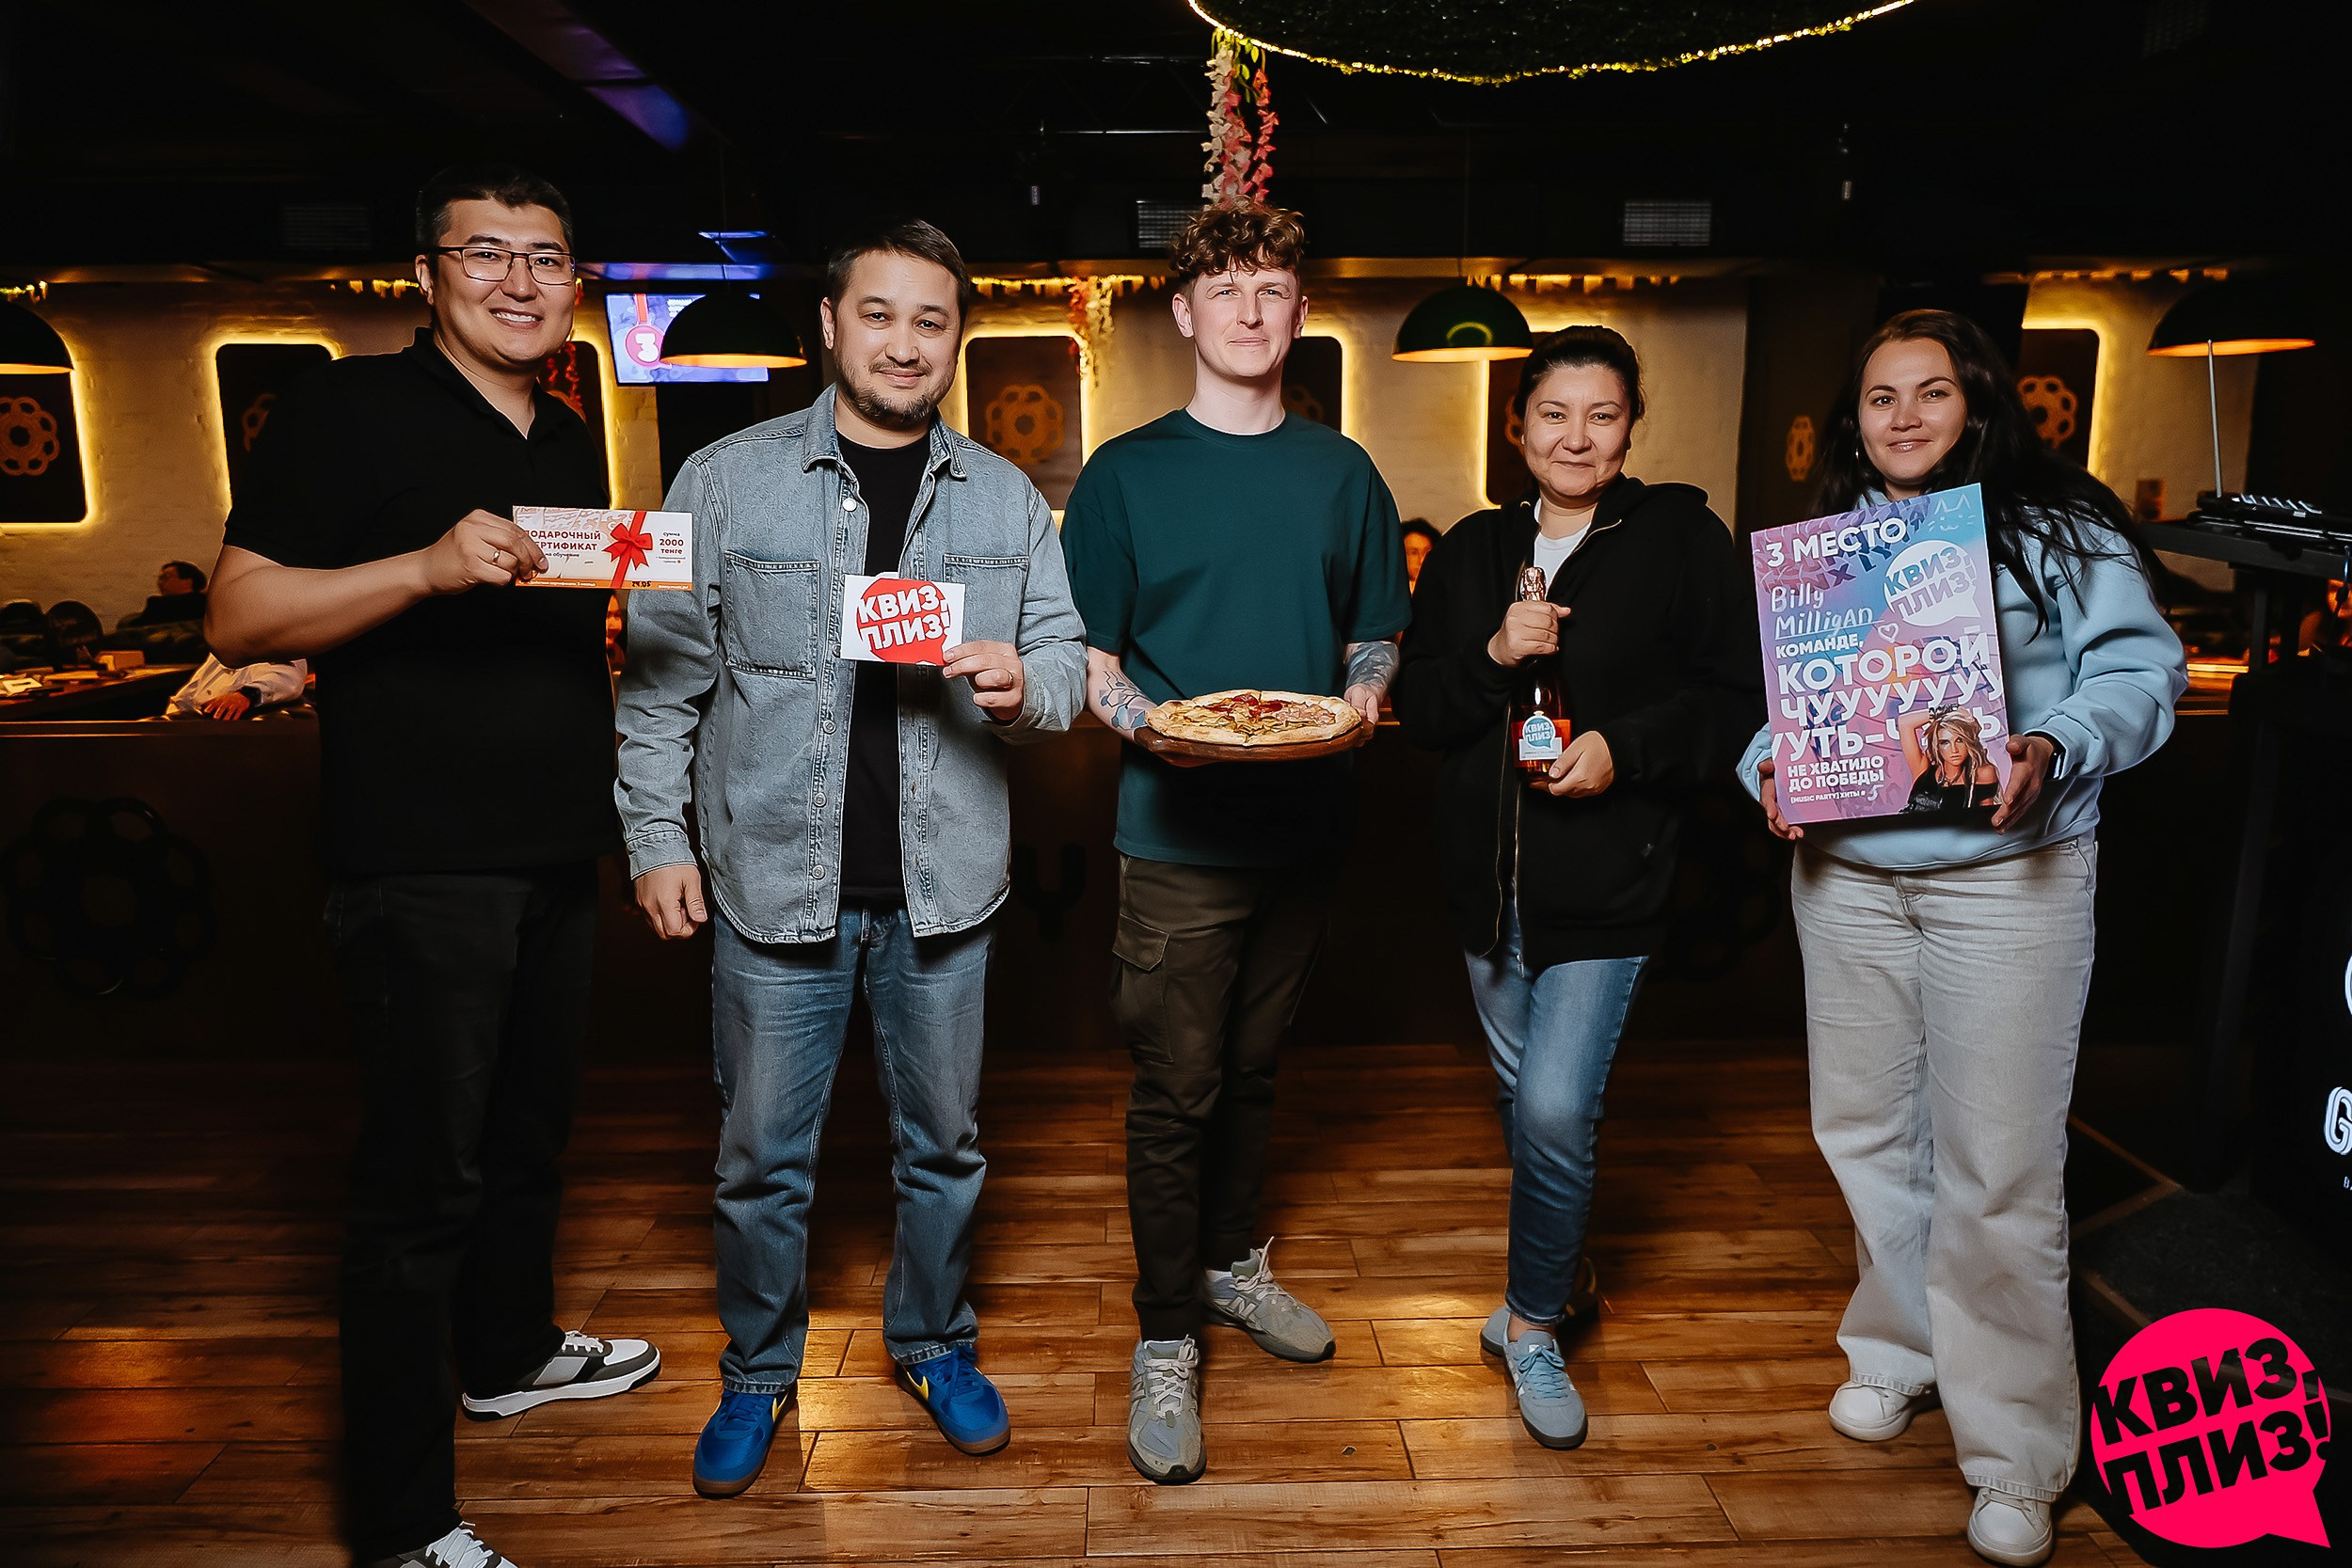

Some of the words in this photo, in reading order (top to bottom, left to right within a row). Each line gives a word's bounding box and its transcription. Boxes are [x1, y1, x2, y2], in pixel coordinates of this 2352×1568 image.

[635, 333, 659, 362] 3
[536, 542, 597, 550] РТИФИКАТ
[1766, 542, 1785, 567] 3
[1793, 517, 1907, 562] МЕСТО
[1772, 582, 1824, 613] Billy
[1891, 565, 1977, 620] ПЛИЗ!
[860, 611, 951, 650] ПЛИЗ!
[1775, 633, 1864, 659] КОМАНДЕ,
[1777, 625, 1991, 695] КОТОРОЙ
[1788, 764, 1806, 778] НЕ
[1810, 755, 1884, 776] ХВАТИЛО
[1788, 777, 1813, 793] ДО
[1816, 769, 1884, 788] ПОБЕДЫ
[1867, 784, 1884, 801] 5
